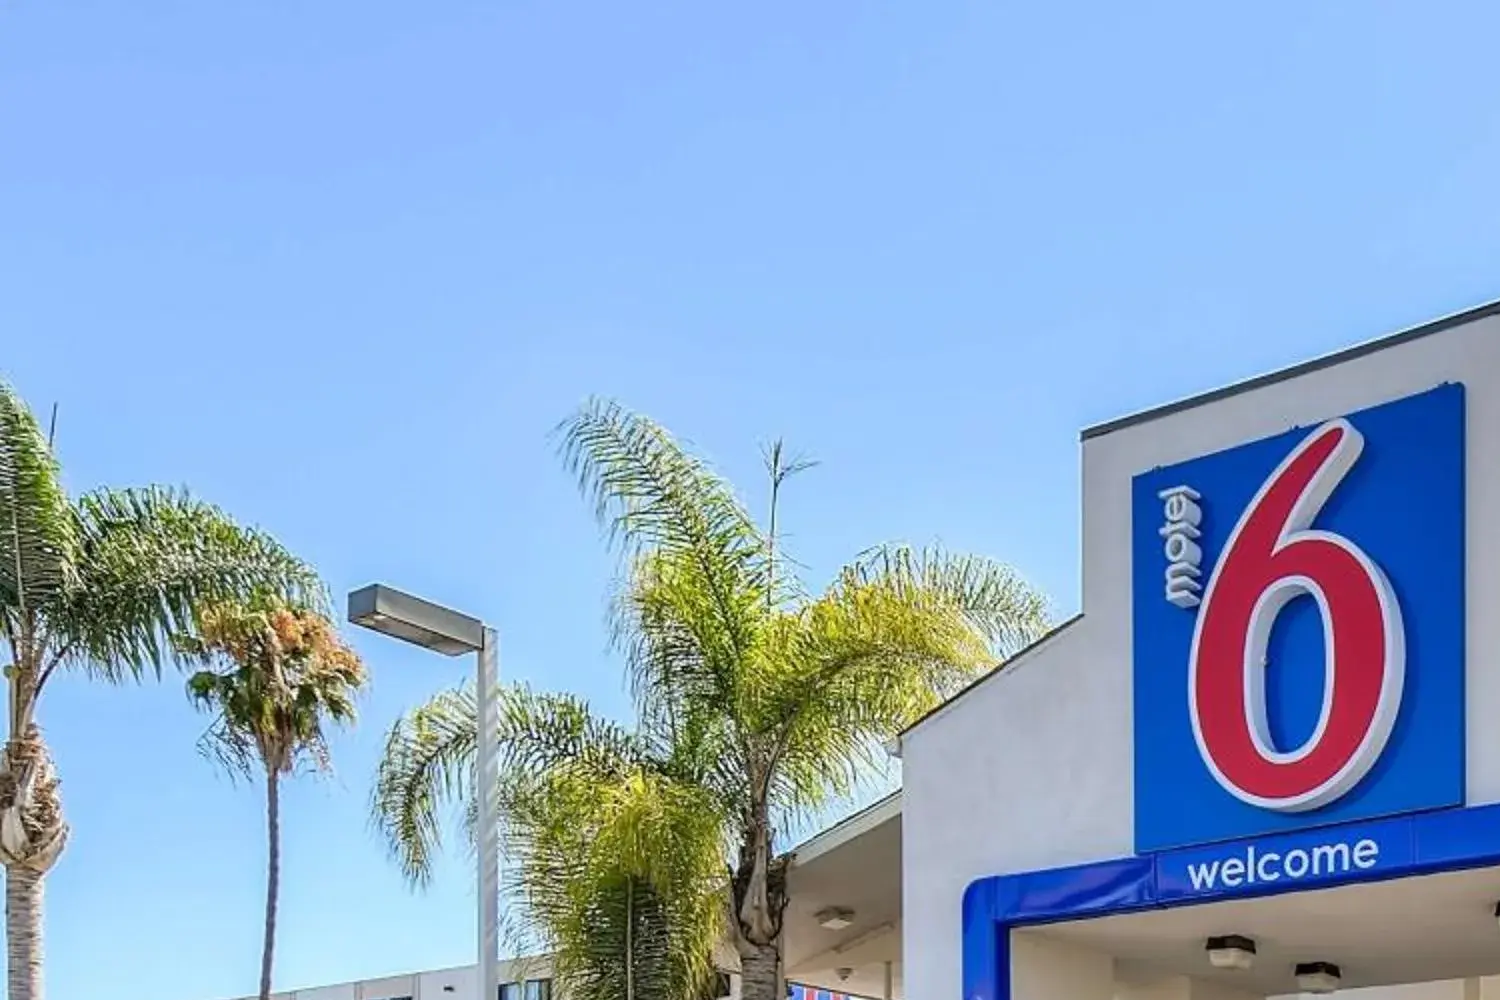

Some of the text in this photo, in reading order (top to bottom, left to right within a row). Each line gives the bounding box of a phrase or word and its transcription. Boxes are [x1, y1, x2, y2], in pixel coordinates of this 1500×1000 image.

[1158, 417, 1406, 812] motel 6
[1187, 839, 1379, 890] welcome
